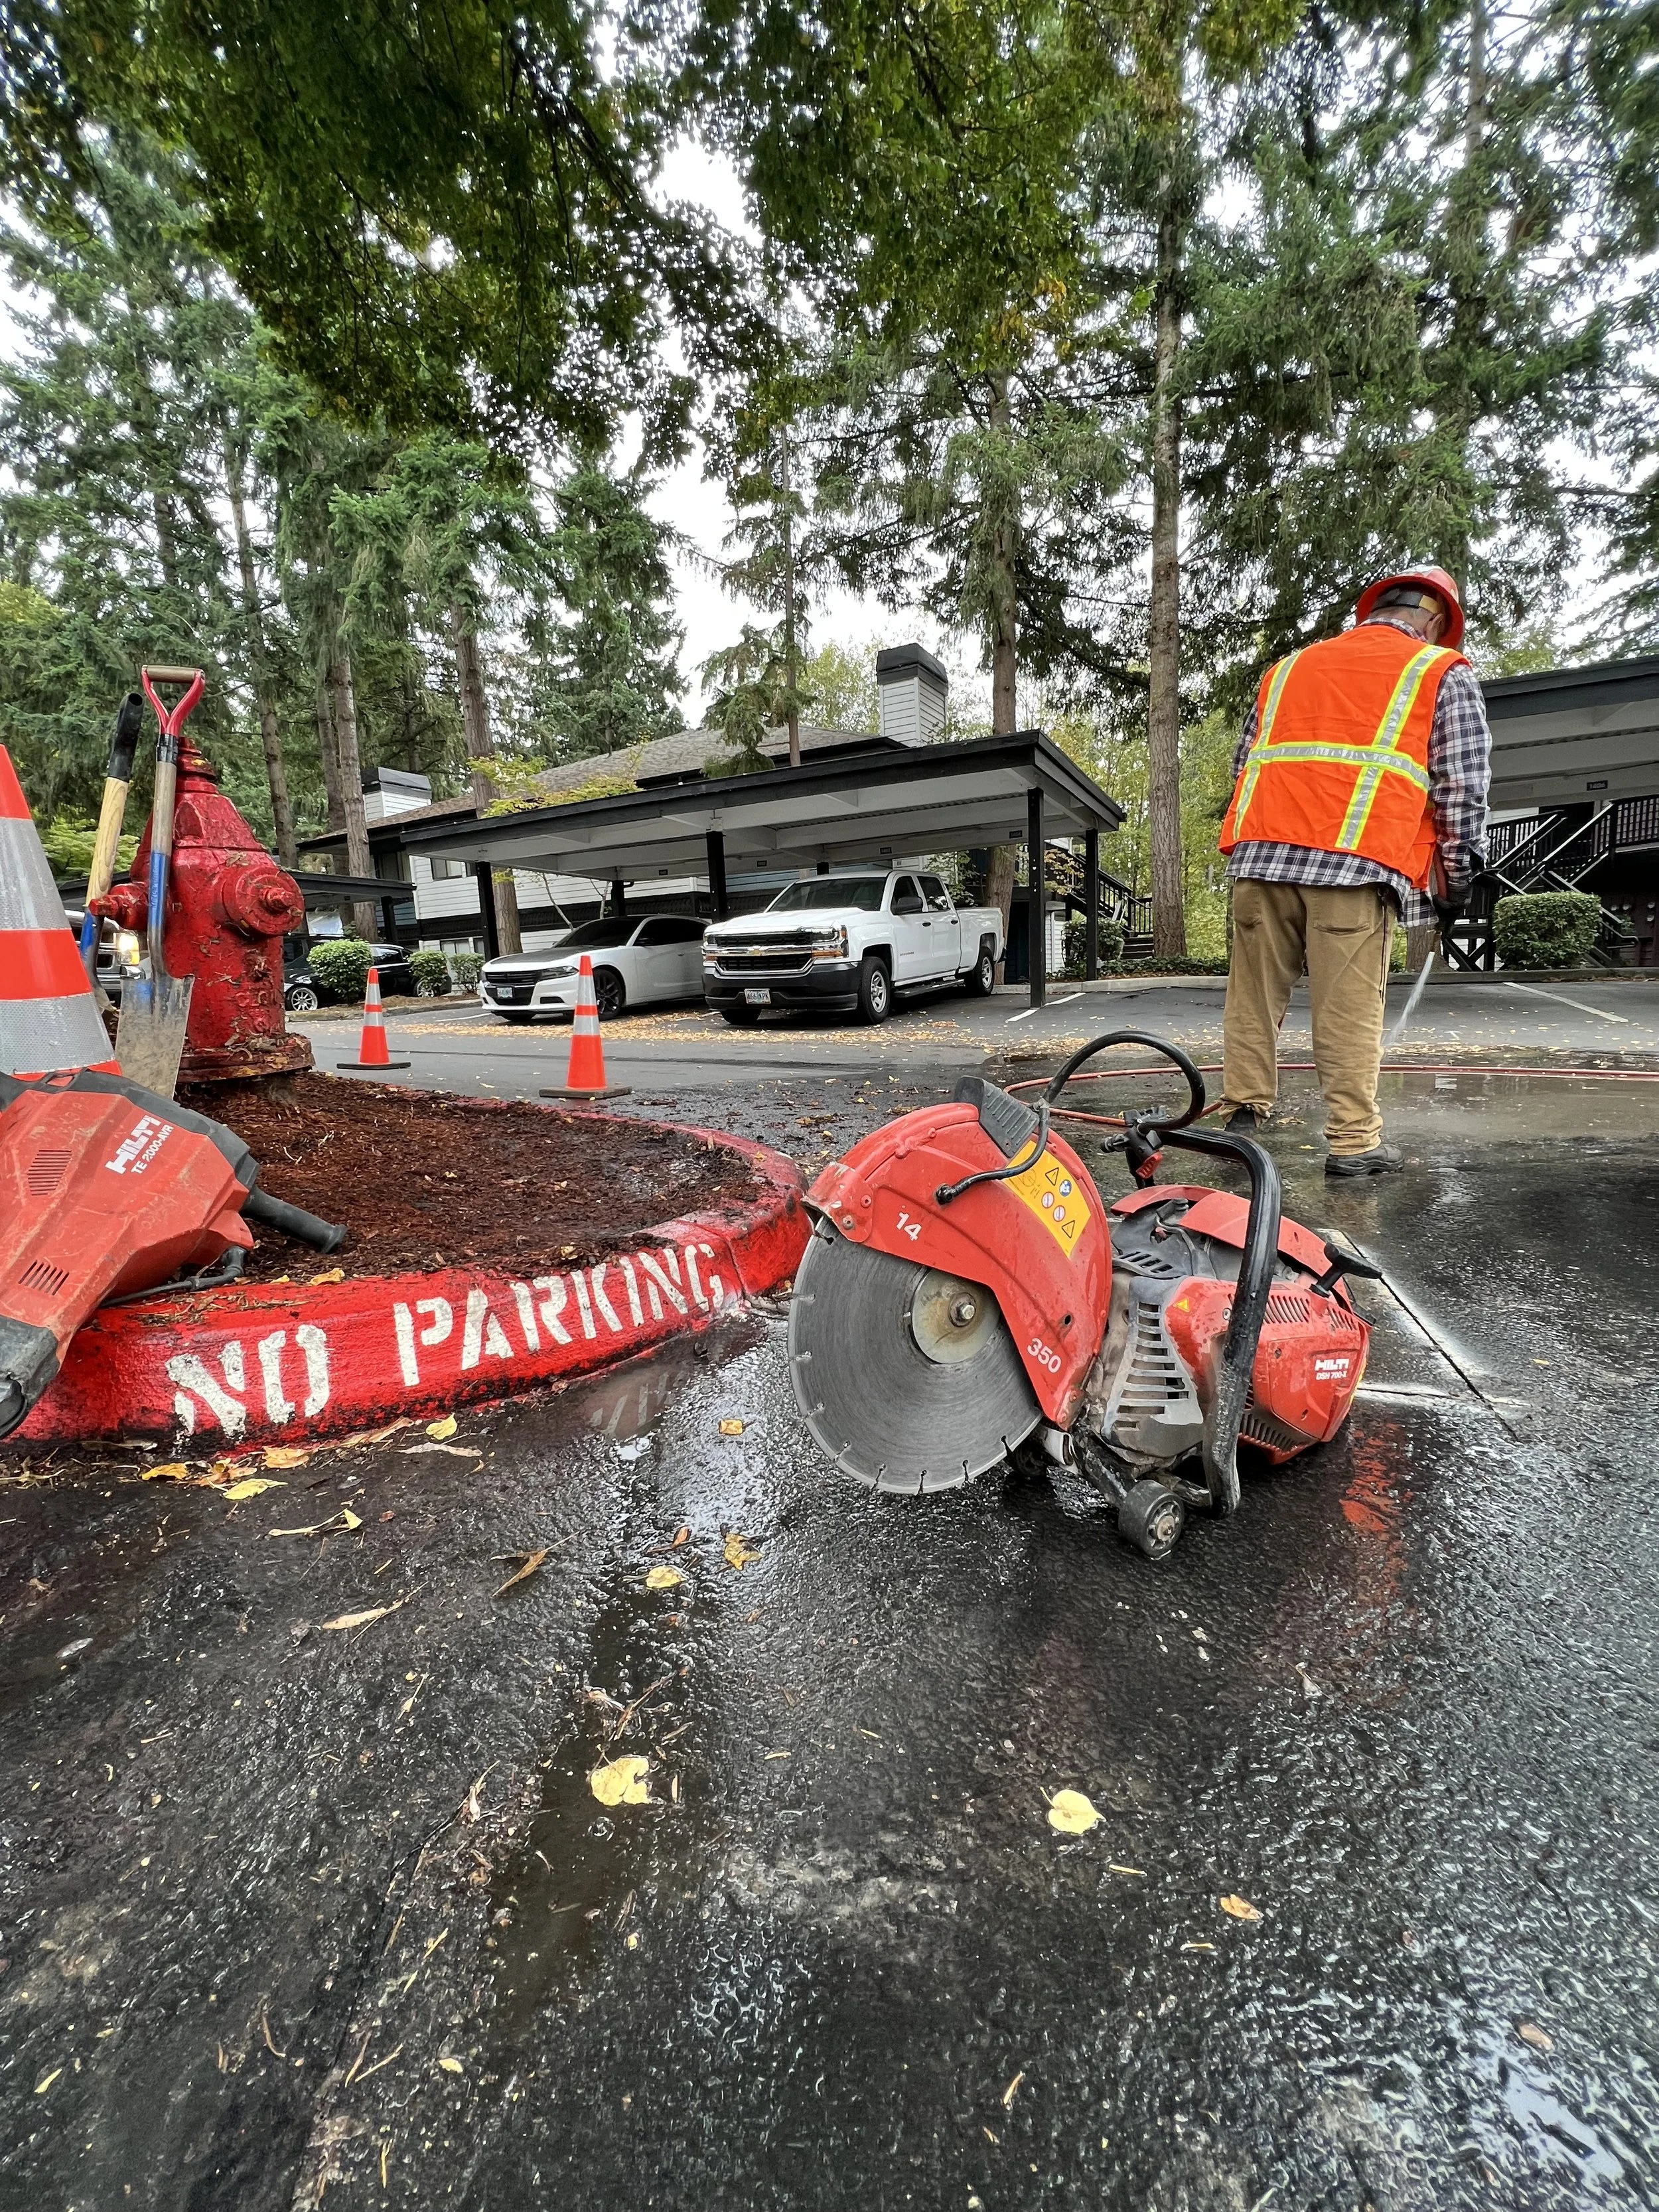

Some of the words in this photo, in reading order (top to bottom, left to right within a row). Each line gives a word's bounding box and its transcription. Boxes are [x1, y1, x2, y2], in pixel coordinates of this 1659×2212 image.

[105, 1114, 161, 1175] HILTI
[131, 1160, 148, 1174] TE
[141, 1124, 175, 1163] 2000-AVR
[896, 1212, 922, 1241] 14
[165, 1324, 330, 1445] NO
[394, 1243, 725, 1387] PARKING
[1027, 1337, 1062, 1373] 350
[1314, 1358, 1350, 1371] HILTI
[1315, 1371, 1331, 1380] DSH
